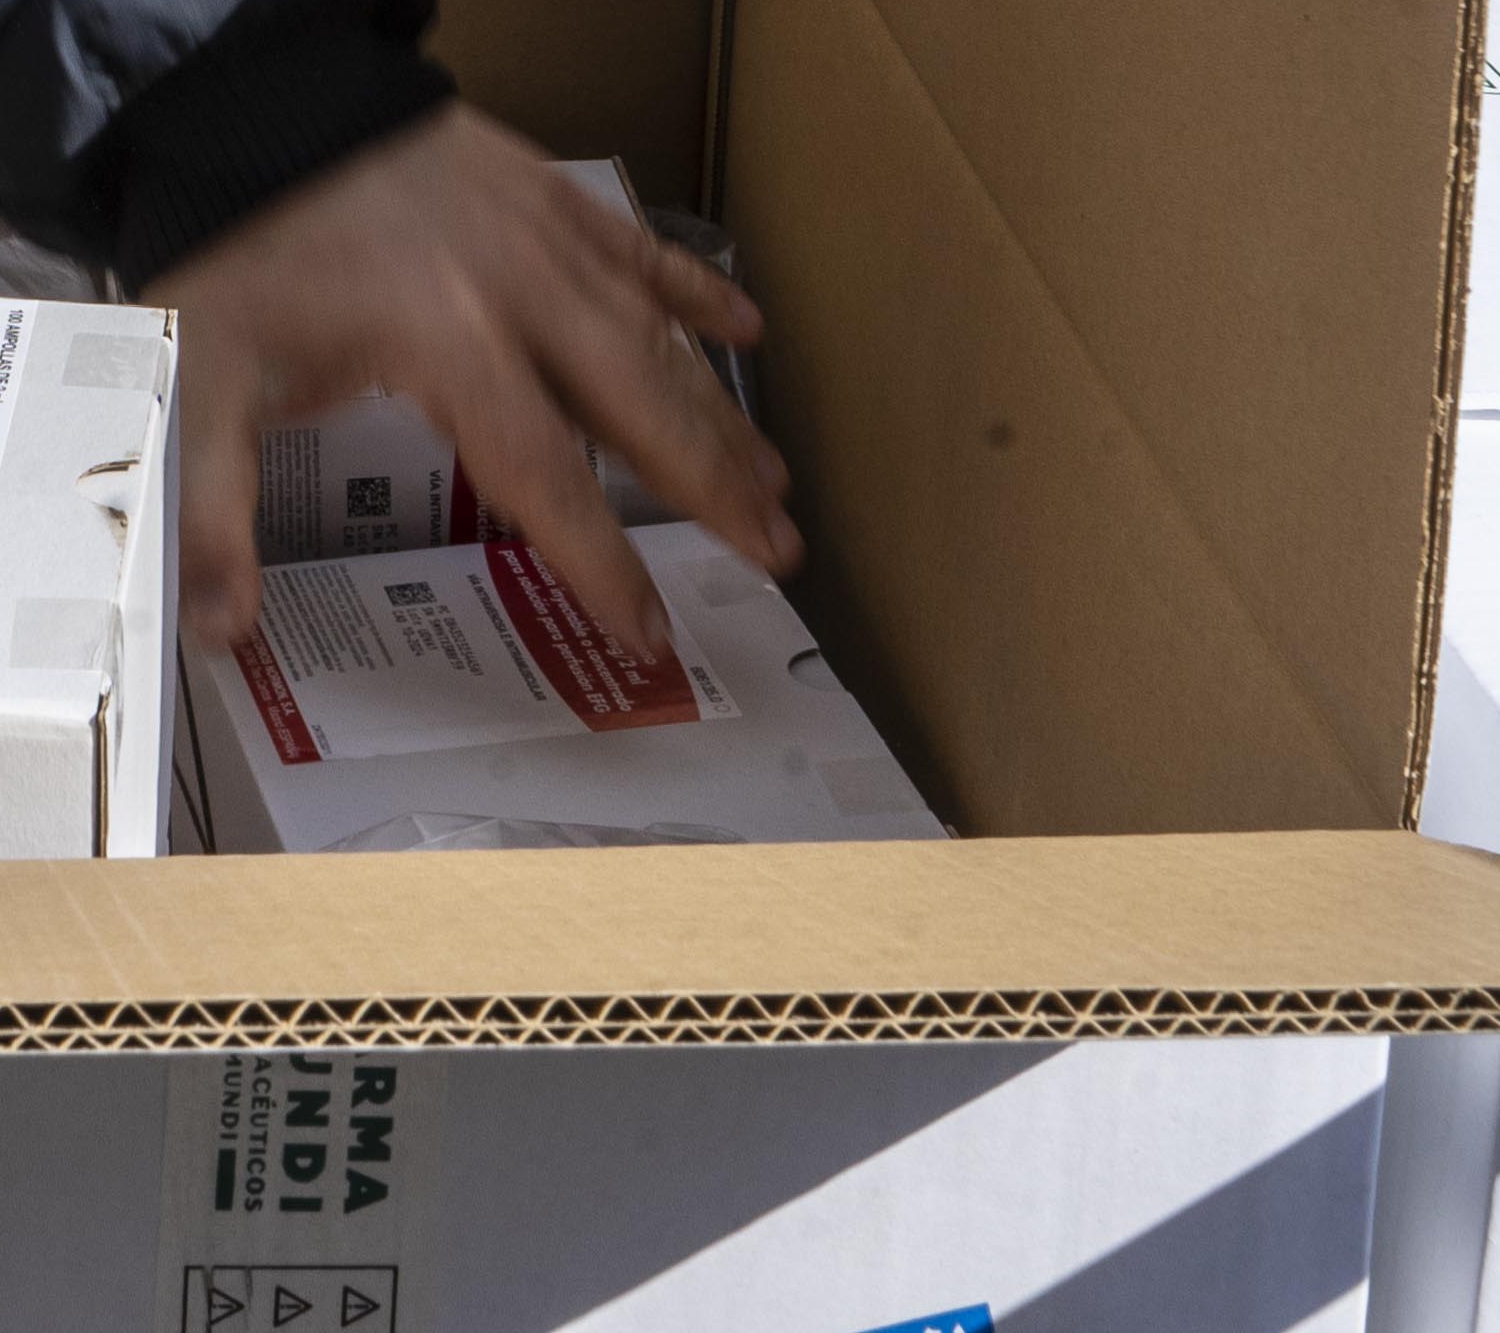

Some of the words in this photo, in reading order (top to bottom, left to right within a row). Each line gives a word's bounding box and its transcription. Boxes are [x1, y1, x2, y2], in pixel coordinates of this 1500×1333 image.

[10, 309, 23, 323] 100
[0, 325, 20, 370] AMPOLLAS
[430, 494, 442, 547] INTRAVE
[499, 548, 523, 576] para
[520, 575, 551, 615] solución
[536, 612, 565, 642] para
[551, 641, 595, 695] perfusión
[586, 691, 611, 714] EFG
[554, 582, 588, 639] inyectable
[584, 639, 593, 648] o
[603, 636, 637, 670] mg/2
[627, 669, 649, 685] ml
[588, 647, 632, 713] concentrado
[244, 1057, 277, 1213] ACÉUTICOS
[279, 1054, 333, 1212] UNDI
[344, 1065, 397, 1214] RMA
